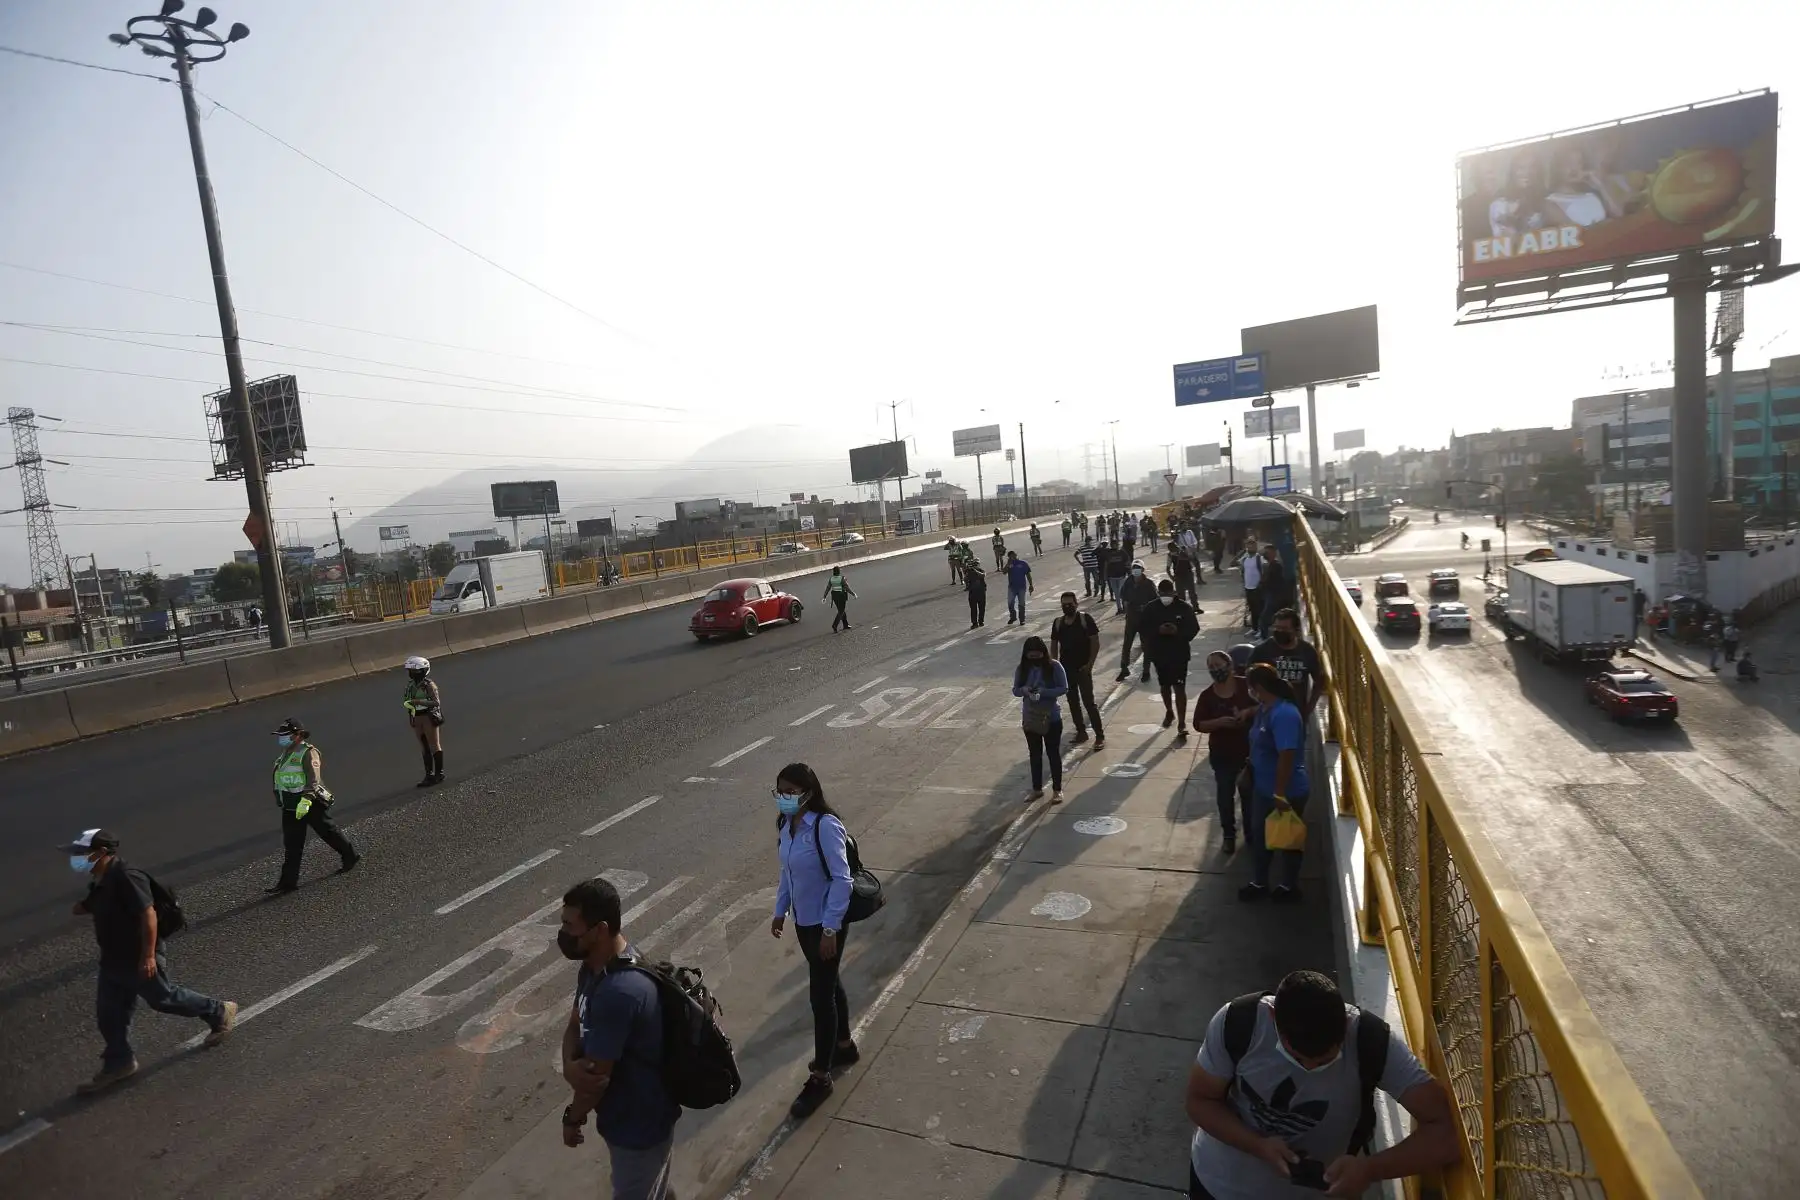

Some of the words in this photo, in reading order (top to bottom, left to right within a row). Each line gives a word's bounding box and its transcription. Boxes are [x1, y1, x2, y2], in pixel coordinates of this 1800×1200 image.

[1474, 237, 1511, 261] EN
[1520, 226, 1579, 254] ABR
[1177, 372, 1228, 388] PARADERO
